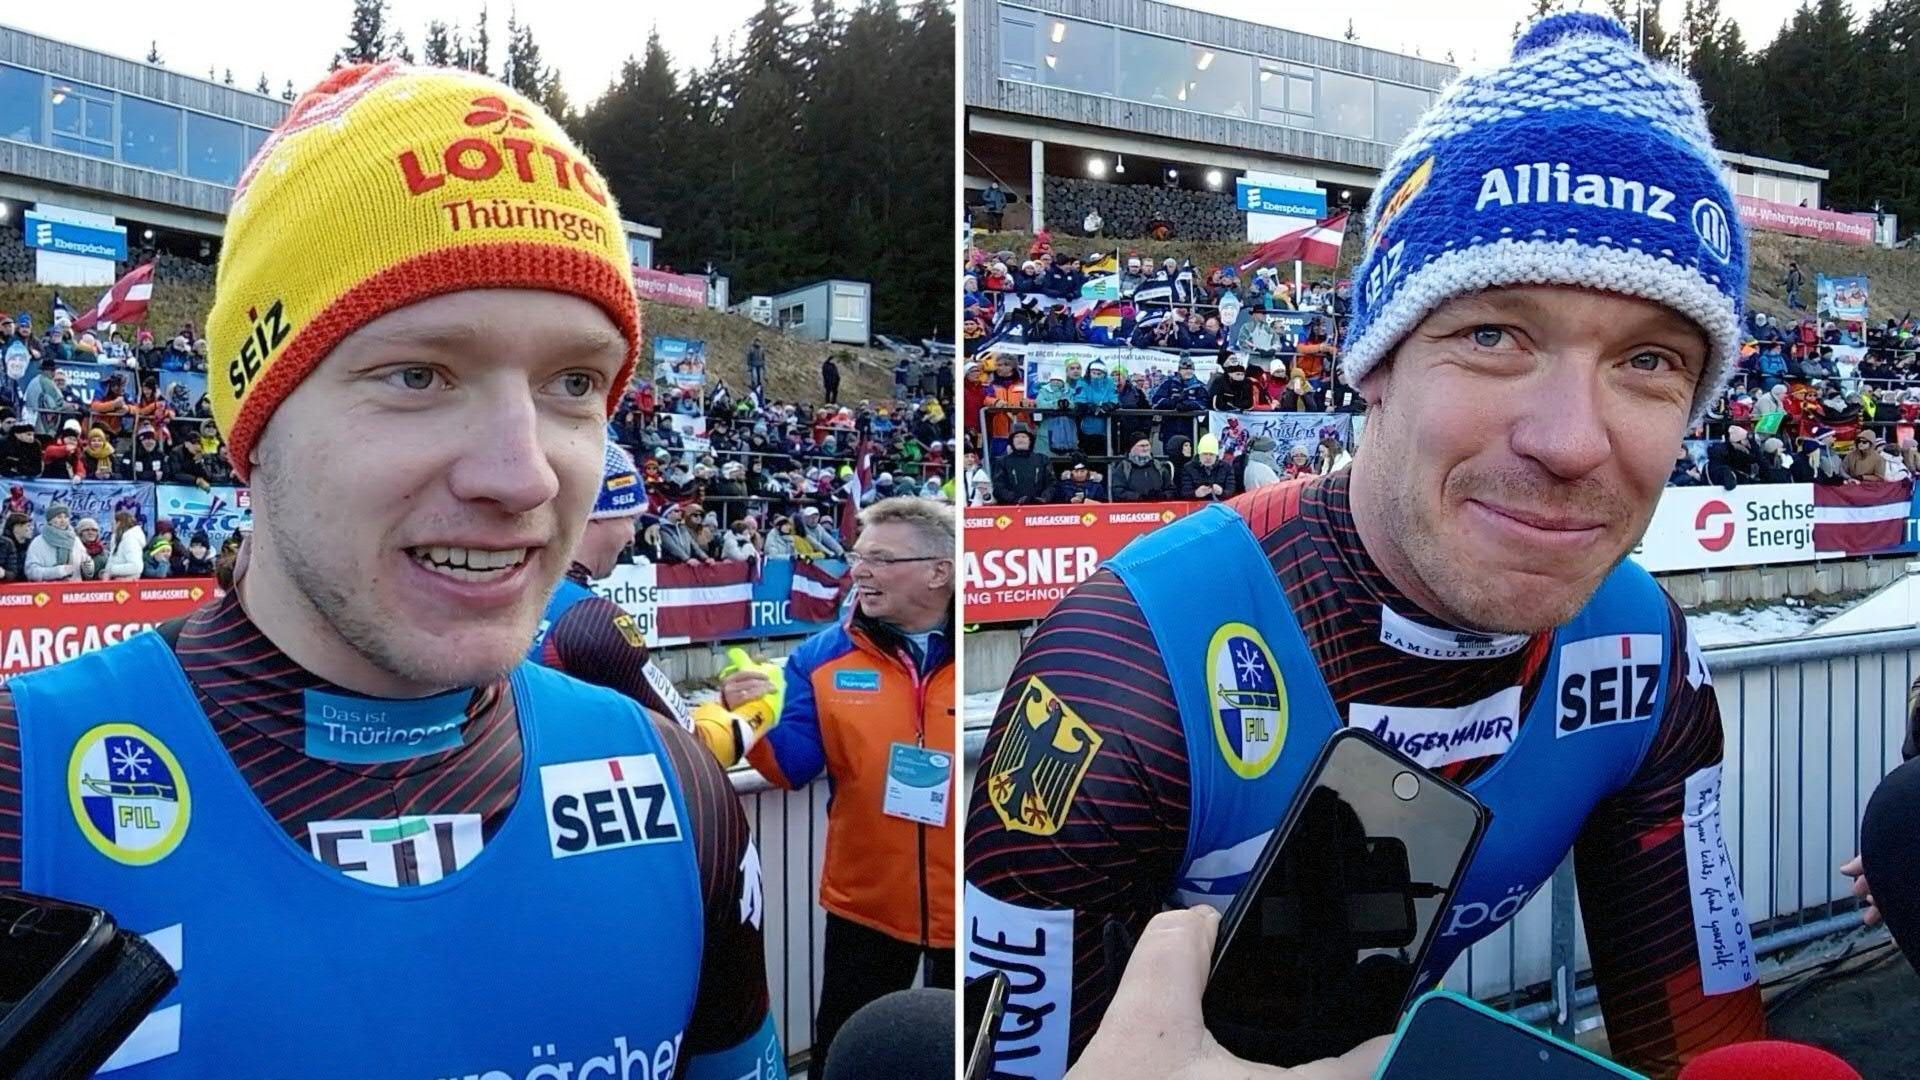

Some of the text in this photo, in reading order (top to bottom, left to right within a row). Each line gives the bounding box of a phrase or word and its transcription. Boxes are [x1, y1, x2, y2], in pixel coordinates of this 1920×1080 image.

[399, 137, 607, 207] LOTTO
[1475, 162, 1676, 223] Allianz
[1262, 201, 1318, 216] Eberspächer
[442, 198, 608, 248] Thüringen
[54, 238, 116, 257] Eberspächer
[229, 299, 292, 400] SEIZ
[612, 492, 636, 506] SEIZ
[964, 517, 994, 528] SSNER
[1024, 514, 1081, 527] HARGASSNER
[1109, 512, 1161, 524] HARGASSNER
[62, 591, 114, 604] HARGASSNER
[140, 588, 189, 601] HARGASSNER
[1383, 630, 1469, 657] FAMILUX
[1559, 637, 1661, 731] SEIZ
[322, 704, 387, 724] Das ist
[1245, 718, 1269, 742] FIL
[1373, 715, 1512, 756] ANGERMAIER
[119, 806, 160, 829] FIL
[552, 760, 678, 852] SEIZ
[1724, 876, 1752, 983] RESORTS
